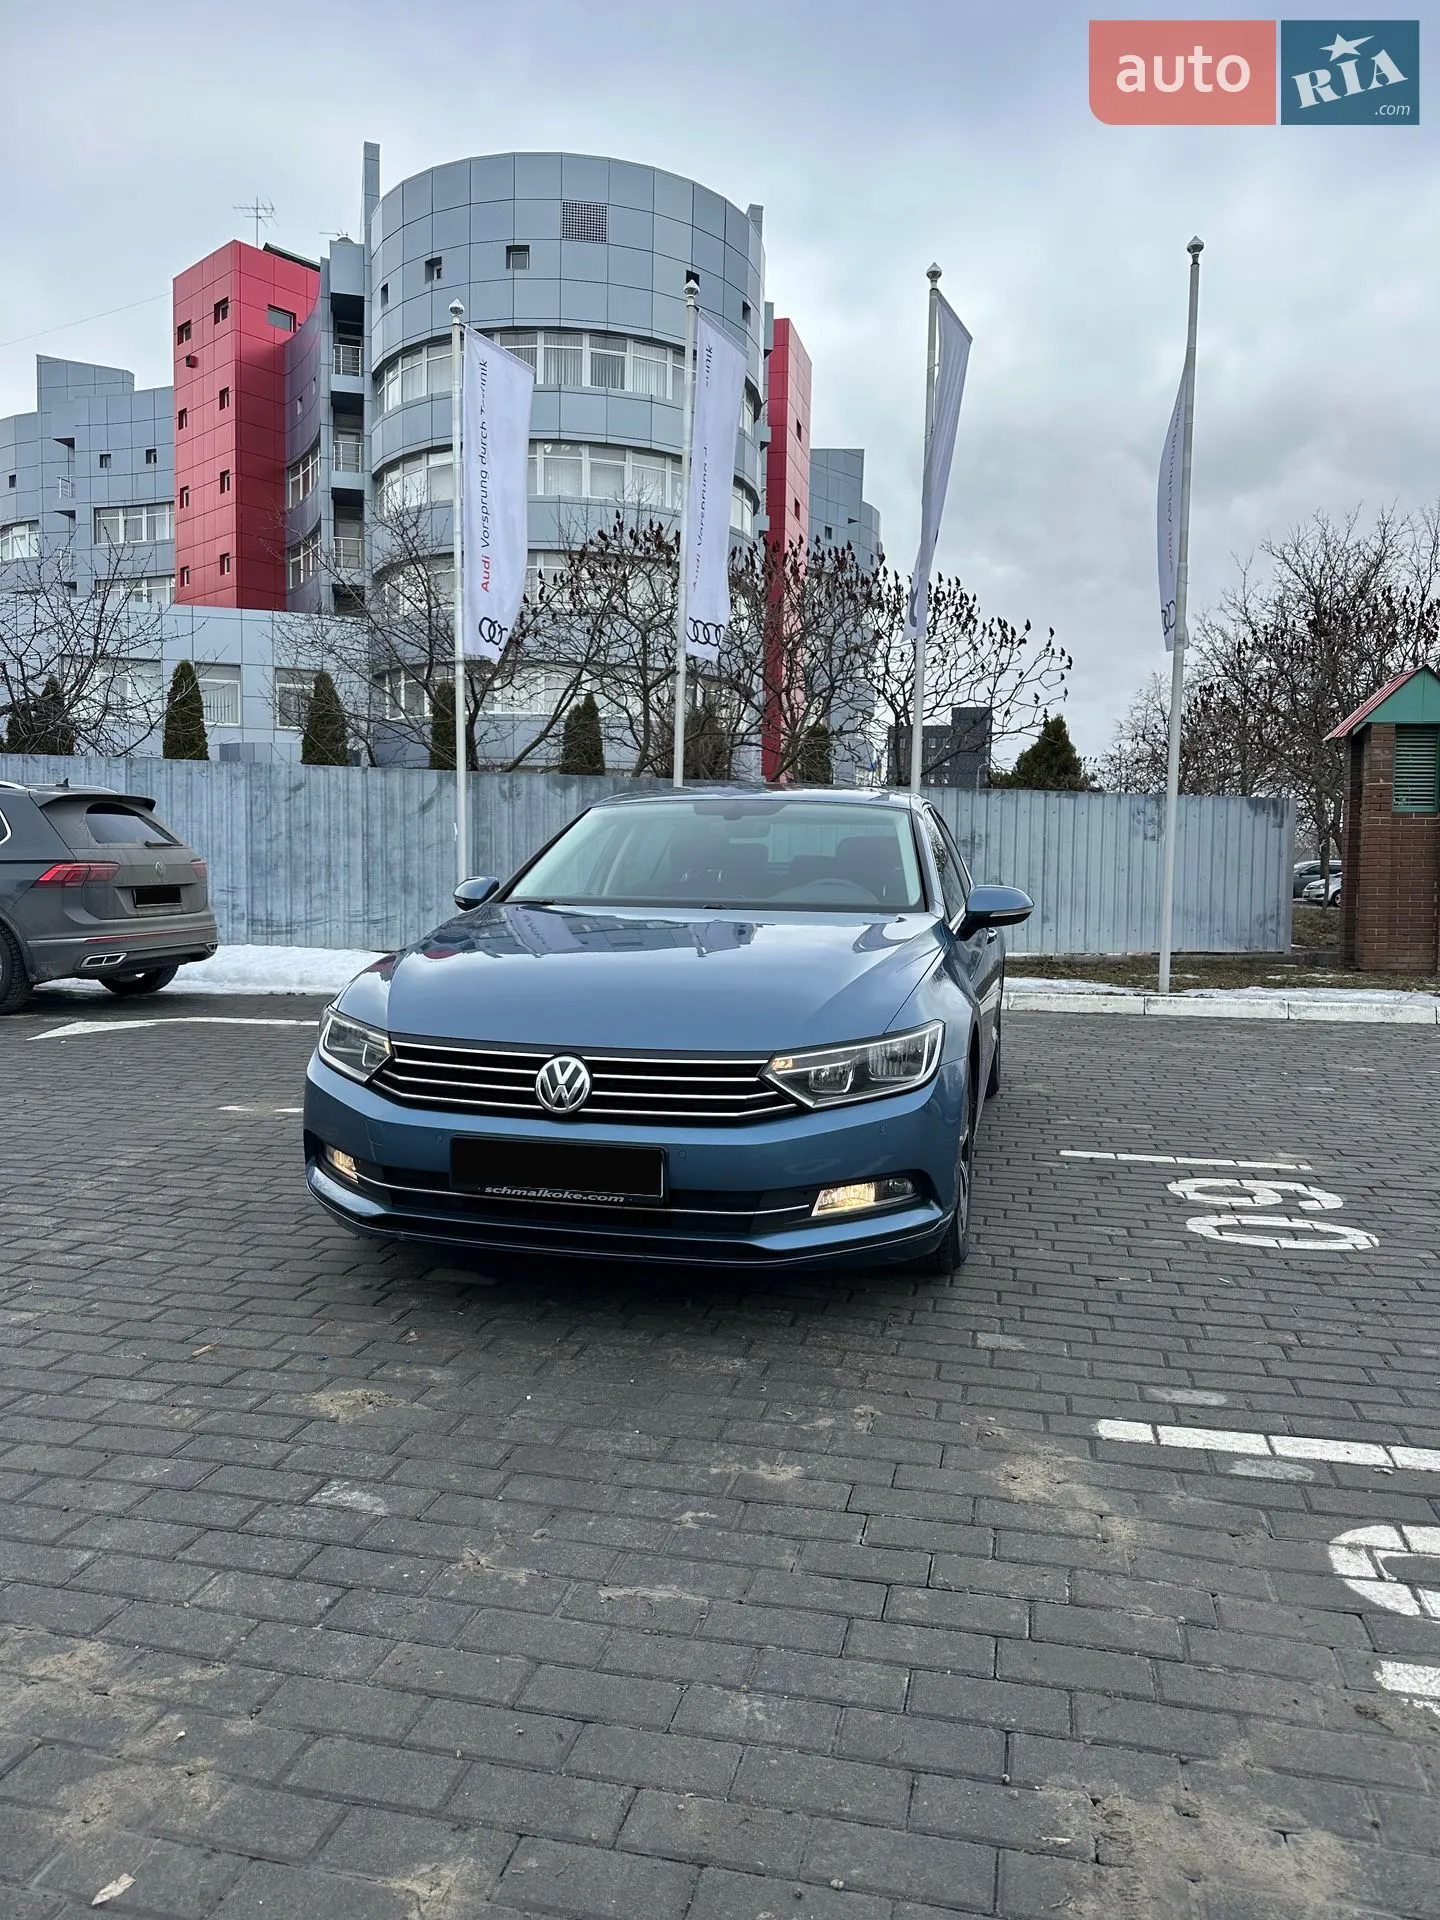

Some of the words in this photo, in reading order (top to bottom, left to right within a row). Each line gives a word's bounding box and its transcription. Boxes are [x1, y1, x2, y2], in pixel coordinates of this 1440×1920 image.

[479, 421, 488, 465] durch
[480, 470, 491, 549] Vorsprung
[481, 554, 491, 592] Audi
[485, 1187, 624, 1202] schmalkoke.com
